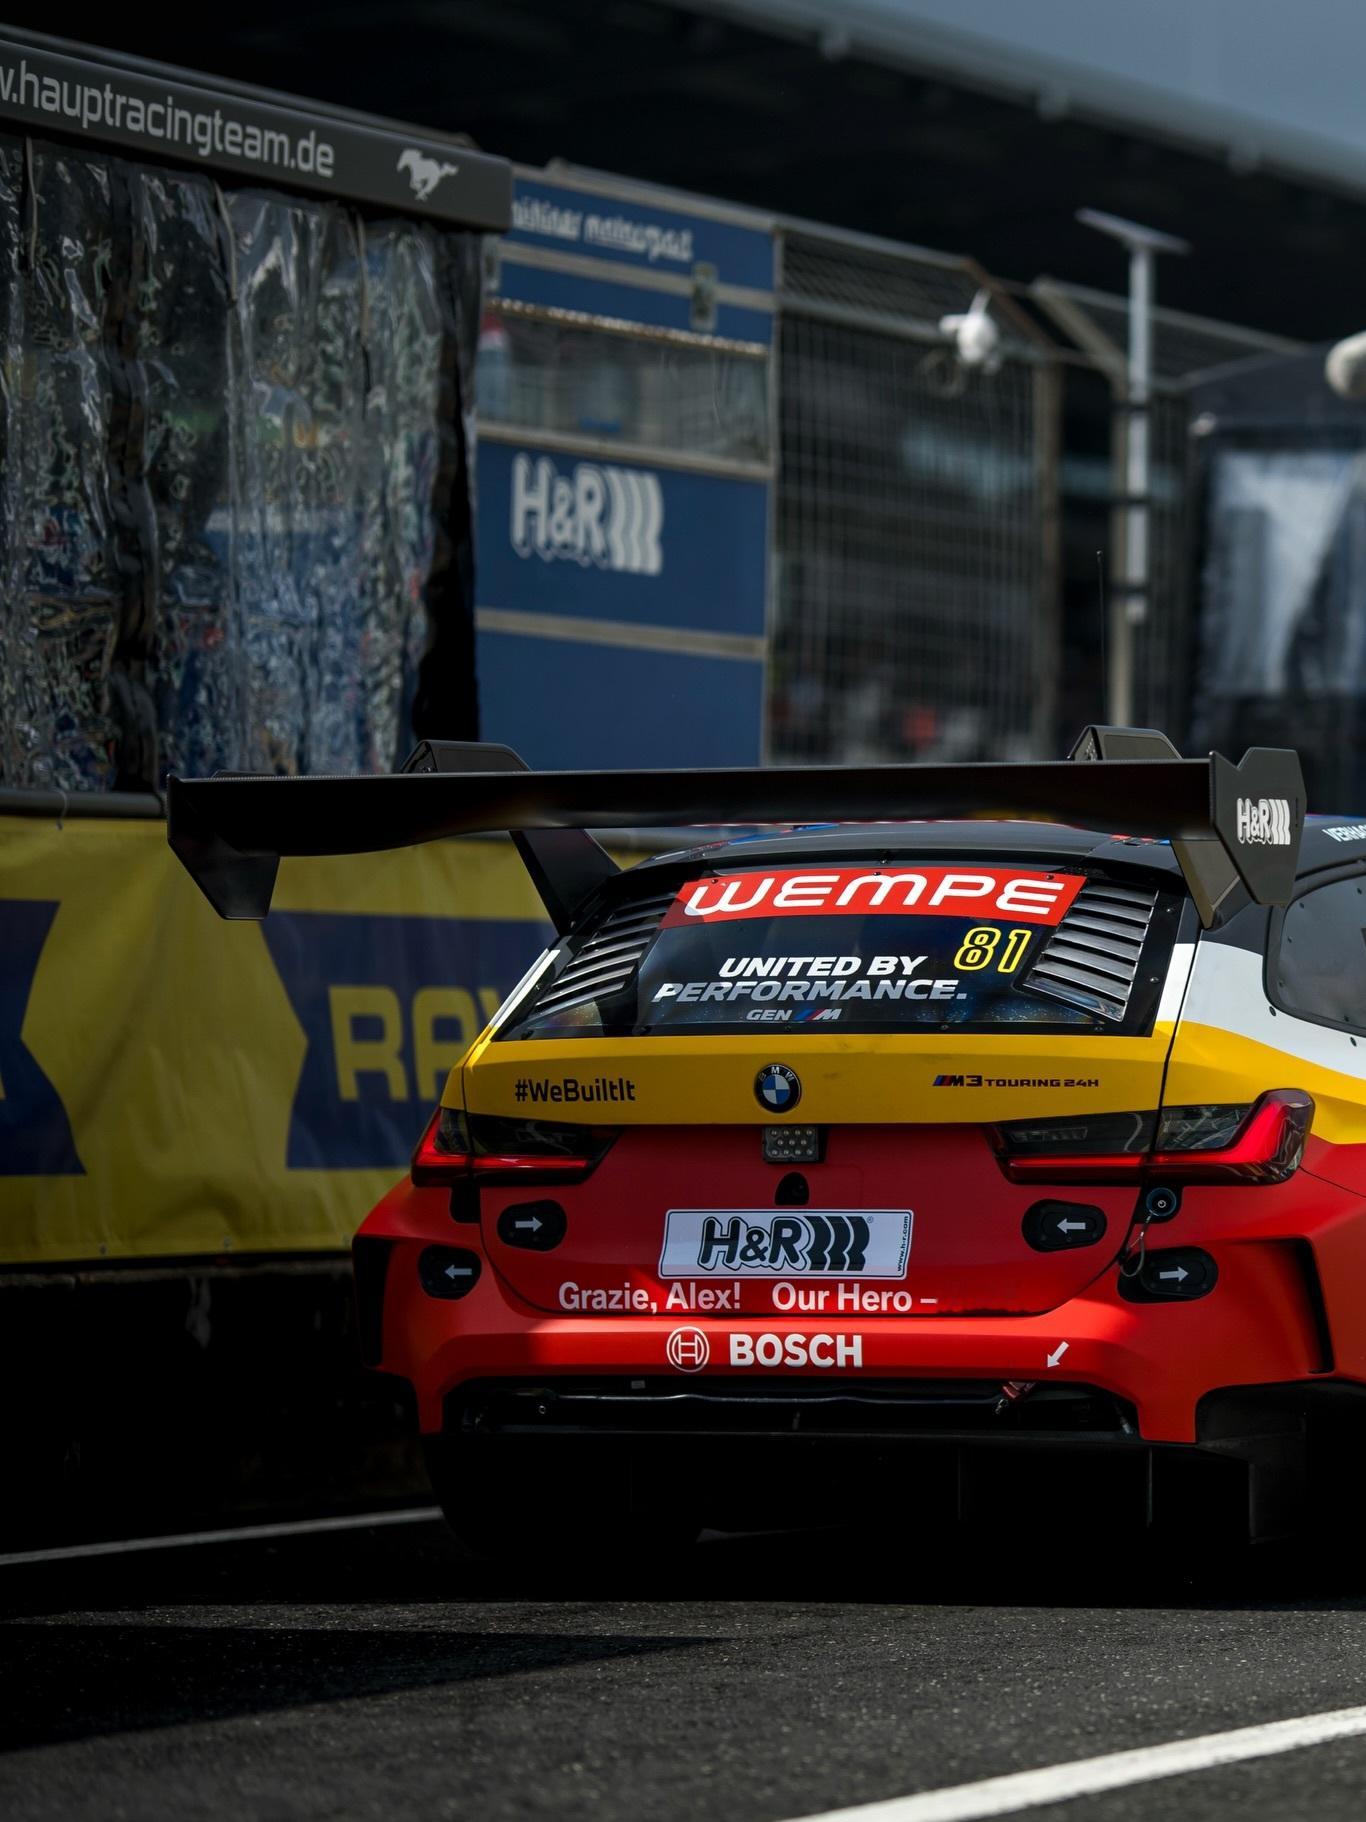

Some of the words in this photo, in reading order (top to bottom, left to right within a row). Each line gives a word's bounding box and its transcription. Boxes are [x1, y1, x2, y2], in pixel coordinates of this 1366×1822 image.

[511, 453, 610, 569] H&R
[1236, 797, 1272, 844] H&R
[684, 873, 1065, 916] WEMPE
[718, 956, 863, 978] UNITED
[866, 955, 928, 976] BY
[952, 926, 1032, 974] 81
[651, 979, 967, 1003] PERFORMANCE.
[746, 1009, 792, 1021] GEN
[514, 1078, 636, 1102] #WeBuiltIt
[758, 1065, 795, 1082] BMW
[946, 1074, 983, 1087] M3
[985, 1078, 1060, 1088] TOURING
[1063, 1078, 1099, 1088] 24H
[697, 1215, 808, 1271] H&R
[896, 1215, 909, 1272] www.h-r.com
[558, 1281, 657, 1314] Grazie,
[665, 1281, 741, 1310] Alex!
[772, 1282, 829, 1311] Our
[838, 1283, 912, 1311] Hero
[729, 1333, 863, 1368] BOSCH
